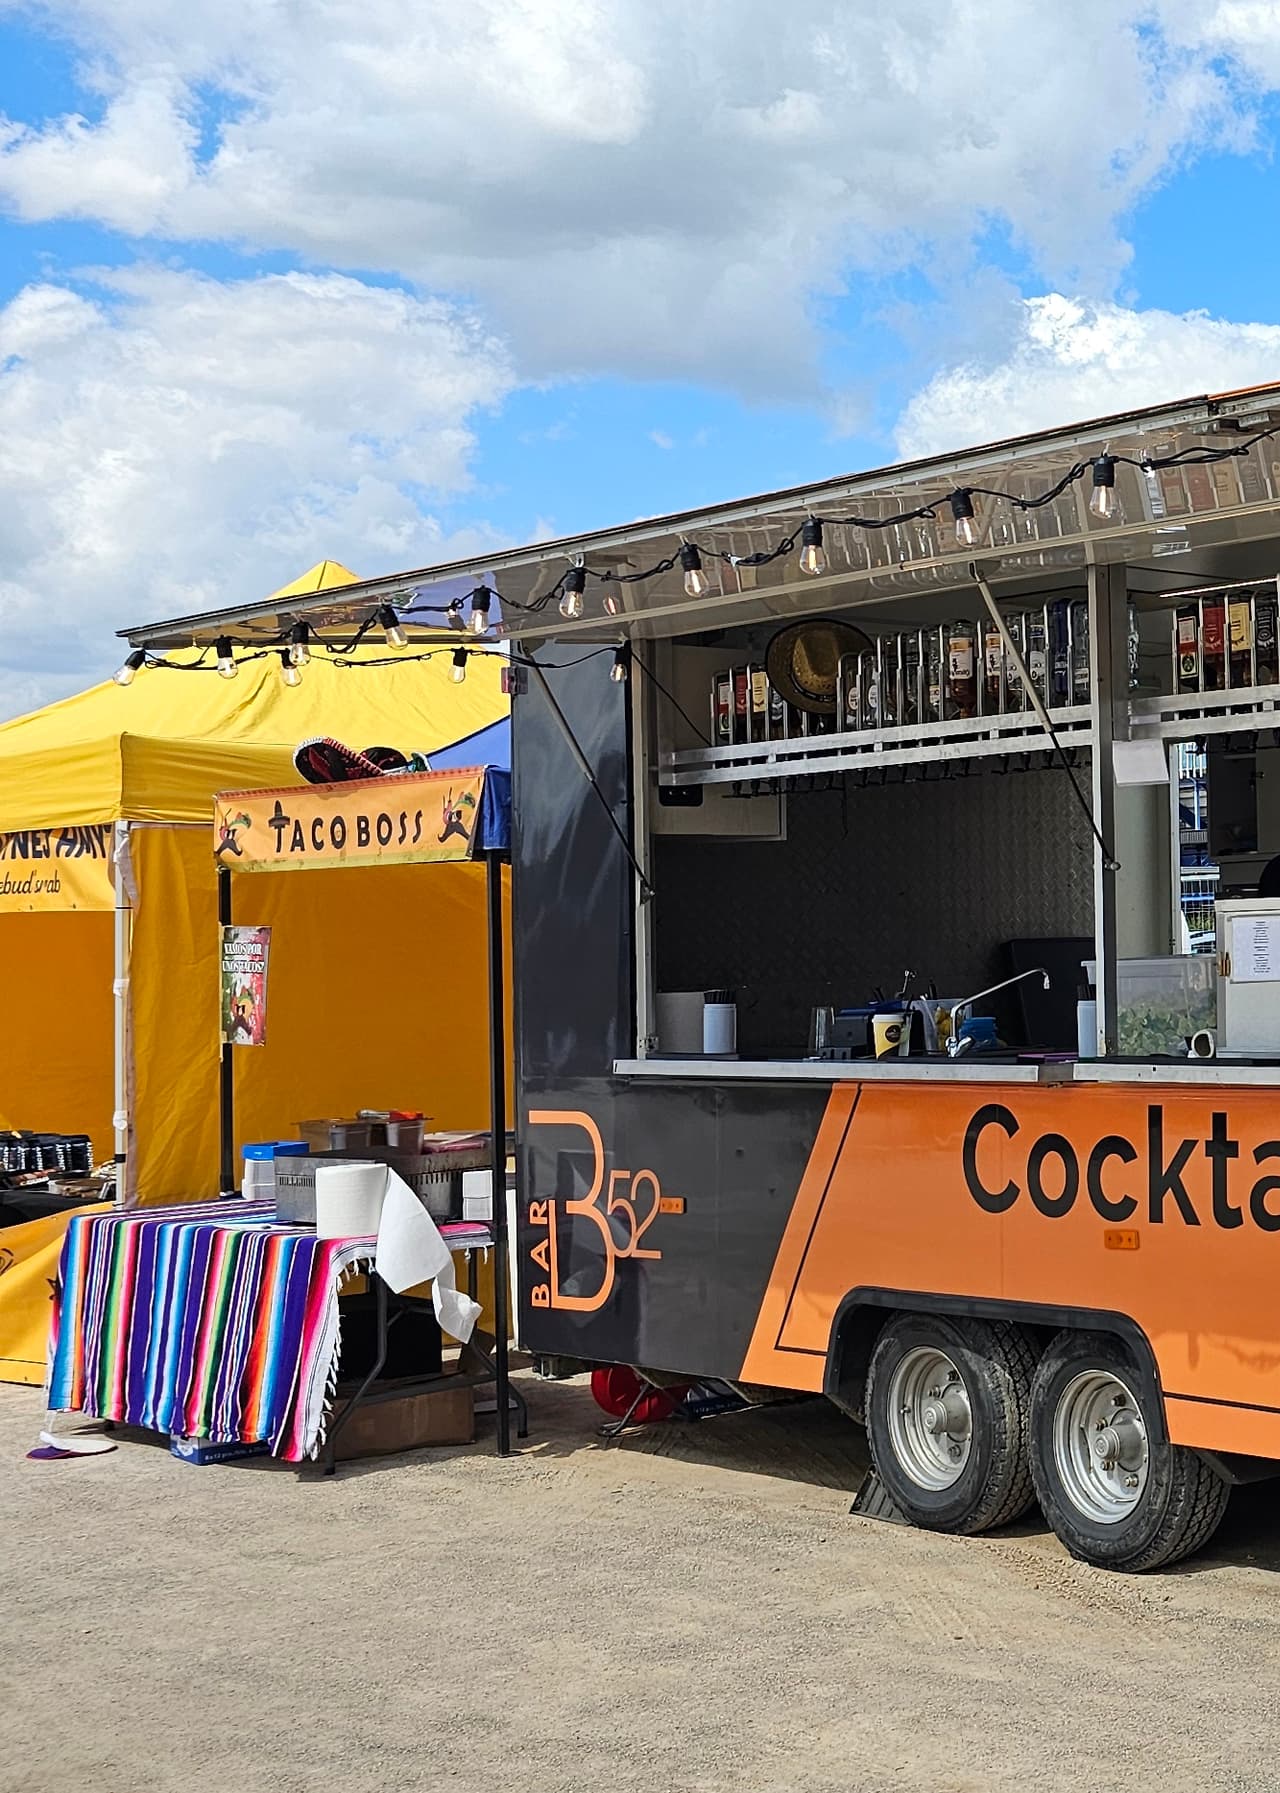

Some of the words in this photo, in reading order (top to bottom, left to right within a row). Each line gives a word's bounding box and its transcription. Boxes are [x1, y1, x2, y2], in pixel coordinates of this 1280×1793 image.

[268, 800, 347, 853] TACO
[356, 810, 423, 848] BOSS
[529, 1199, 550, 1308] BAR
